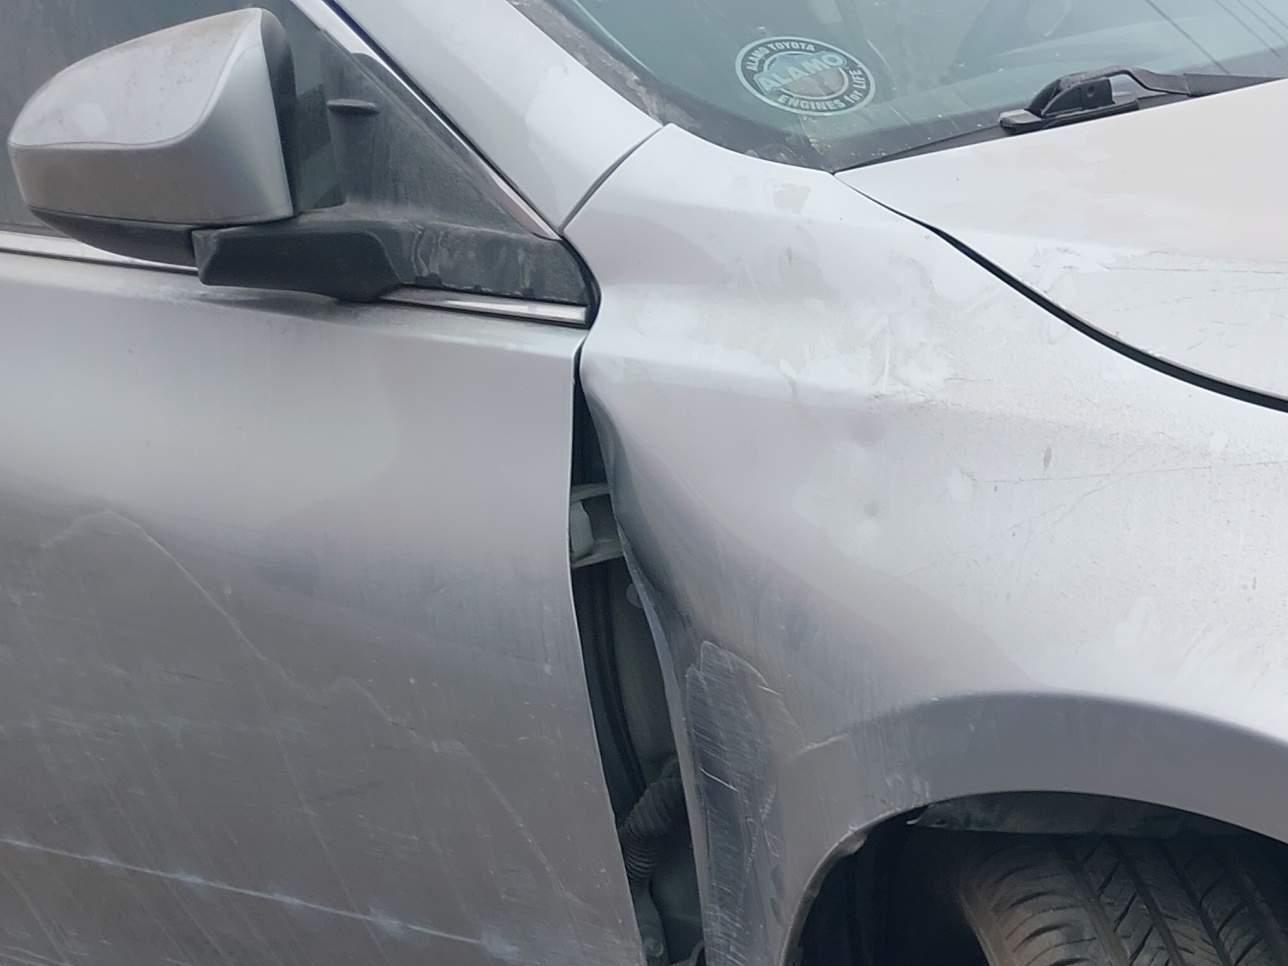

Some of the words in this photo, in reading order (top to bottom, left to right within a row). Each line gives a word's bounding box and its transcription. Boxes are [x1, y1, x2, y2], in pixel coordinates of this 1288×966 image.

[746, 45, 770, 72] ALAMO
[768, 41, 816, 52] TOYOTA
[757, 52, 845, 93] ALAMO
[848, 69, 867, 89] LIFE
[777, 94, 846, 111] ENGINES
[843, 90, 863, 104] for
